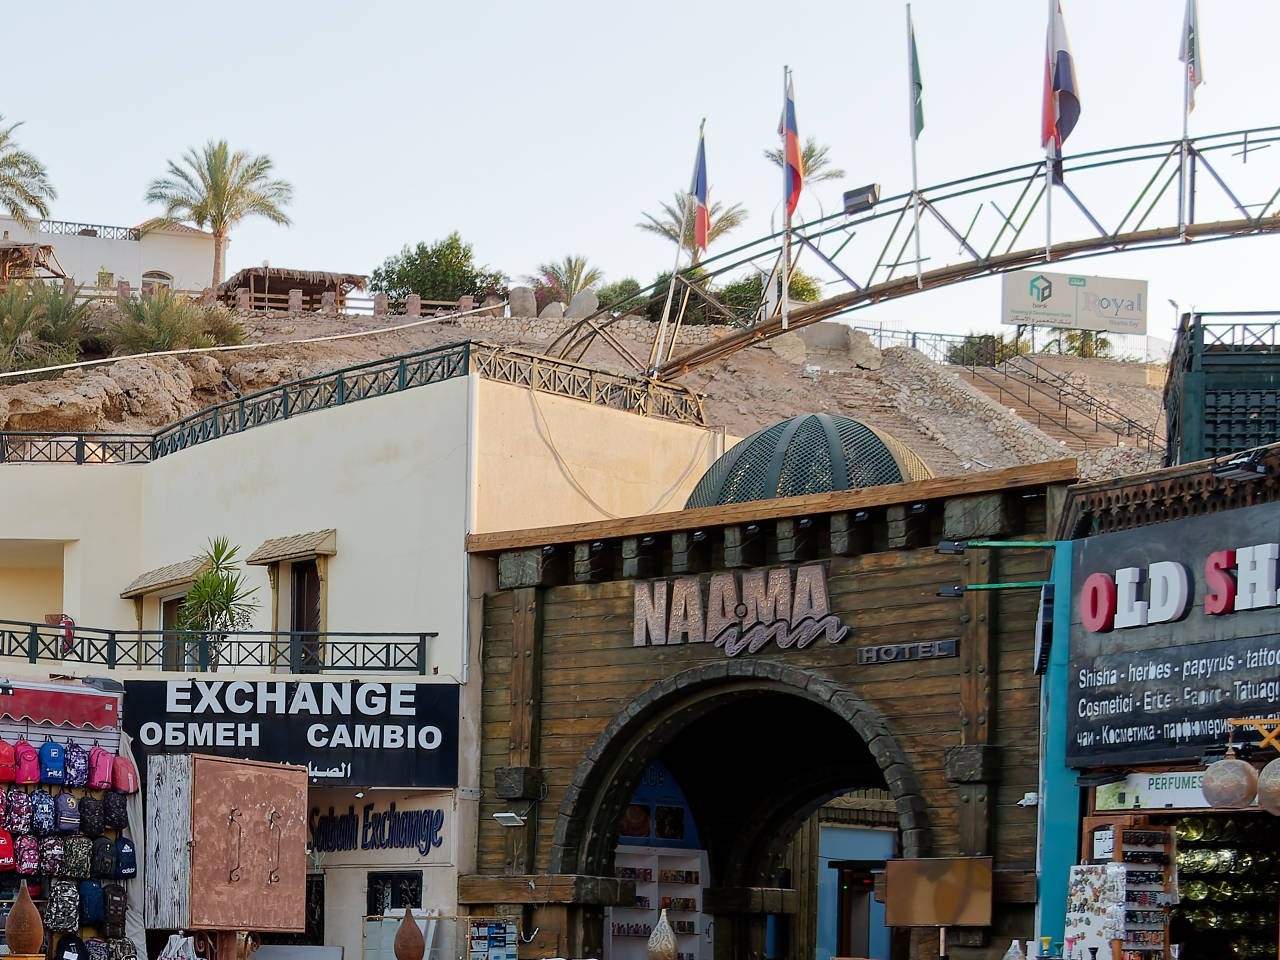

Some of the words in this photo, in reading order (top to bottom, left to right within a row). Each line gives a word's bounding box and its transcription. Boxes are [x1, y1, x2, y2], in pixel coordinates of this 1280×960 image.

[1080, 561, 1188, 633] OLD
[1204, 543, 1280, 615] SH
[633, 564, 830, 647] NAAMA
[714, 603, 849, 657] inn
[863, 642, 951, 662] HOTEL
[1078, 668, 1117, 689] Shisha
[1182, 655, 1234, 681] papyrus
[166, 680, 416, 716] EXCHANGE
[1078, 693, 1132, 718] Cosmetici
[139, 722, 259, 747] ОБМЕН
[306, 724, 442, 750] CAMBIO
[1102, 722, 1155, 745] Косметика
[1148, 776, 1204, 791] PERFUMES
[362, 801, 445, 856] Exchange
